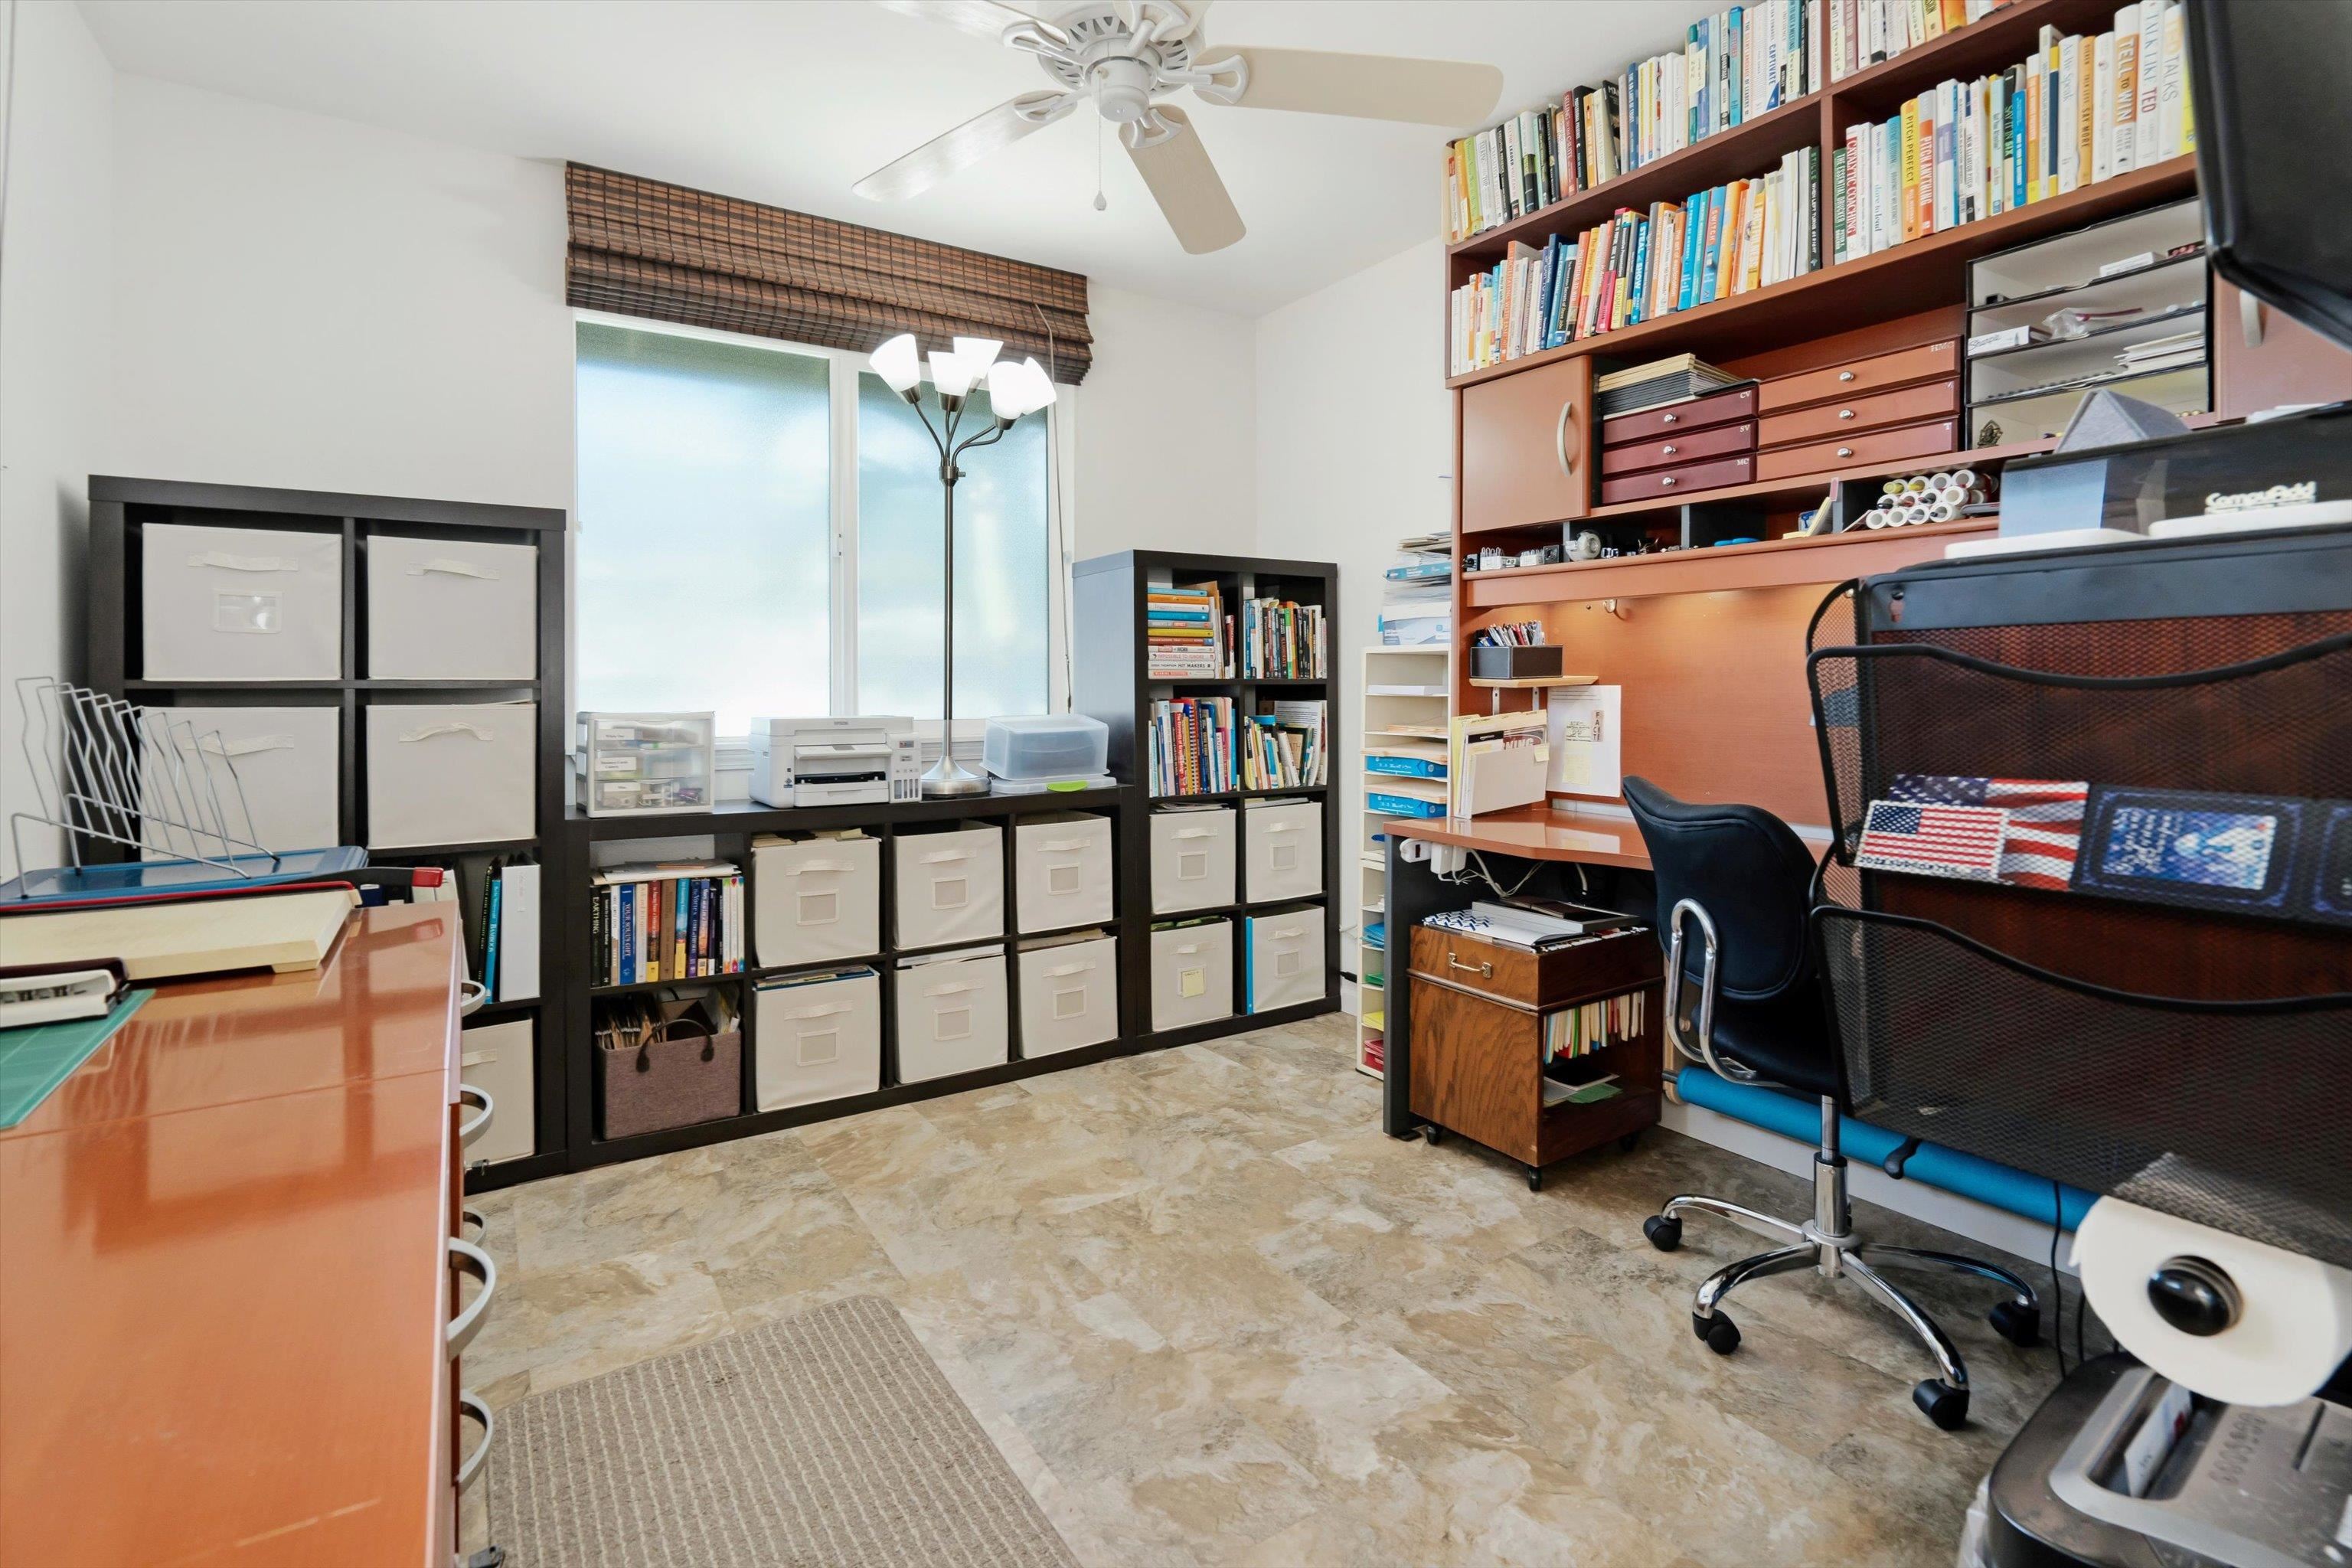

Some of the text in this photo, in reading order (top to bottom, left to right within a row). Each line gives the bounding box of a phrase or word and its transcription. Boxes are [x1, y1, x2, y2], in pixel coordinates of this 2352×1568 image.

[1788, 6, 1795, 15] TO
[2060, 44, 2074, 102] As We Speak
[2141, 11, 2158, 113] TALK LIKE TED
[2117, 37, 2135, 122] TELL TO WIN
[2161, 54, 2180, 103] TALKS
[2004, 106, 2014, 120] SAY
[2081, 108, 2090, 123] SAY
[1905, 115, 1915, 182] PITCH PERFECT
[2004, 131, 2013, 139] IN
[2004, 141, 2014, 156] SIX
[2081, 126, 2090, 149] MORE
[1919, 136, 1933, 206] PITCH ANYTHING
[1836, 154, 1846, 224] THE ESSENTIAL DRUCKER
[1846, 140, 1857, 233] CATALYTIC COACHING
[1874, 184, 1883, 204] dare
[1709, 209, 1718, 242] SWITCH
[1874, 214, 1883, 231] lead
[1574, 250, 1584, 281] PRESENTING
[1635, 226, 1647, 289] STEAL SHOW
[1505, 256, 1514, 299] FACILITATING
[1584, 266, 1593, 292] Presenter
[1740, 390, 1752, 399] CV
[1740, 424, 1751, 433] SV
[1944, 422, 1952, 430] T
[1736, 457, 1749, 466] MC
[488, 923, 497, 952] BAMBOOS
